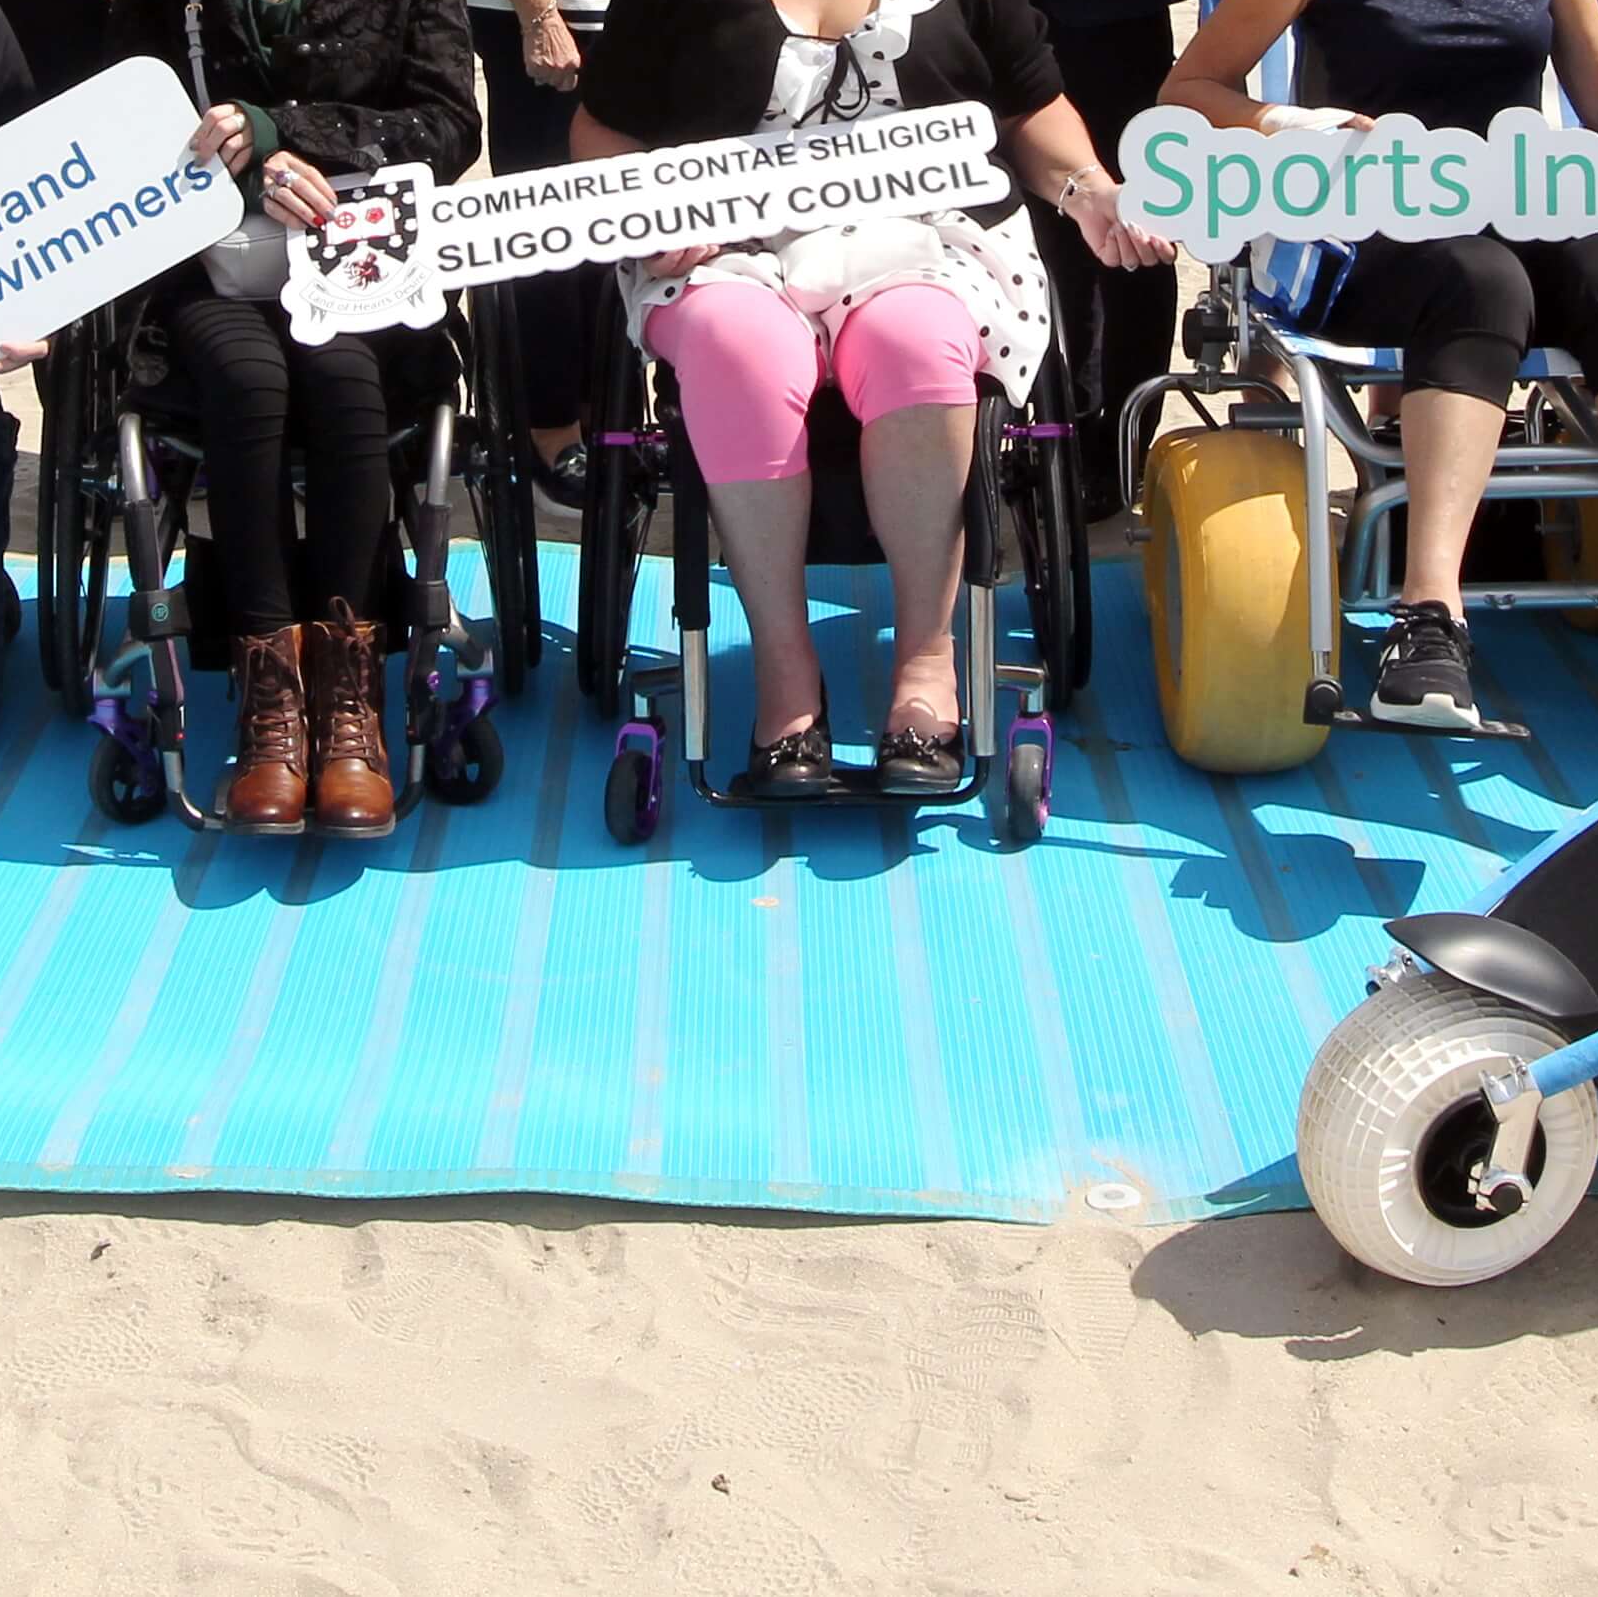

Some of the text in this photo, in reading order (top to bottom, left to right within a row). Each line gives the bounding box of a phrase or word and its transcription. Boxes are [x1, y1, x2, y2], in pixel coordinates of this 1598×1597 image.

[430, 115, 977, 225] COMHAIRLE CONTAE SHLIGIGH
[436, 159, 990, 273] SLIGO COUNTY COUNCIL
[1141, 131, 1470, 239] Sports
